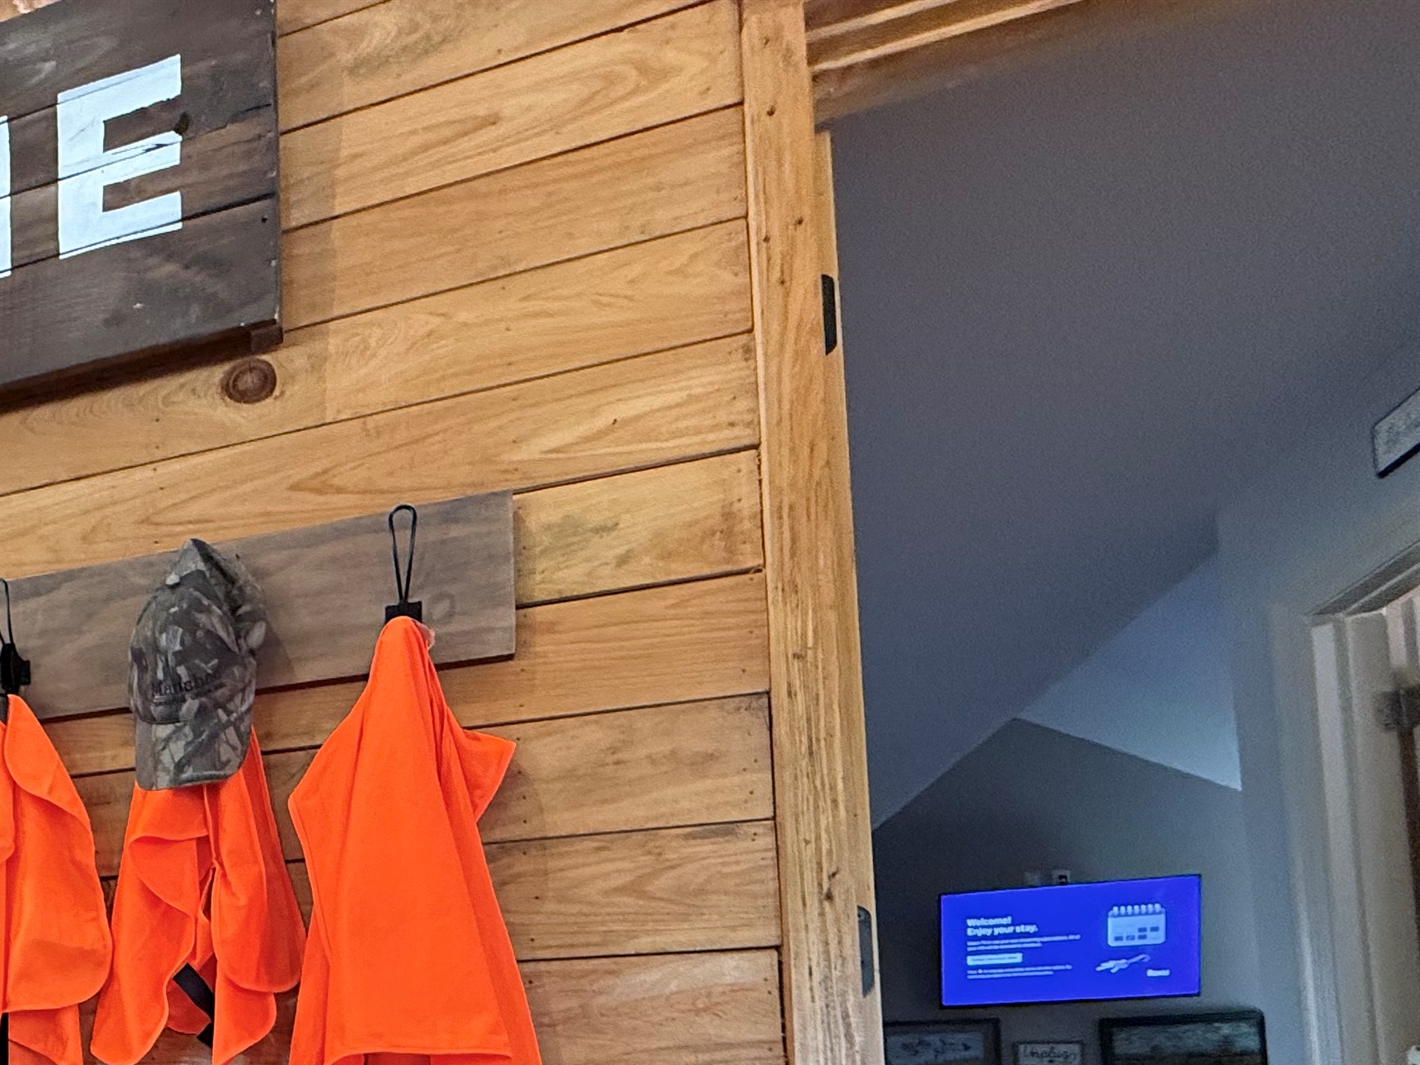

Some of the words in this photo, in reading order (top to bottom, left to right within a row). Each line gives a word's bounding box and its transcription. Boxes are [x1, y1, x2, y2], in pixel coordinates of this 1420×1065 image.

[966, 916, 1012, 927] Welcome!
[966, 927, 992, 937] Enjoy
[993, 926, 1015, 936] your
